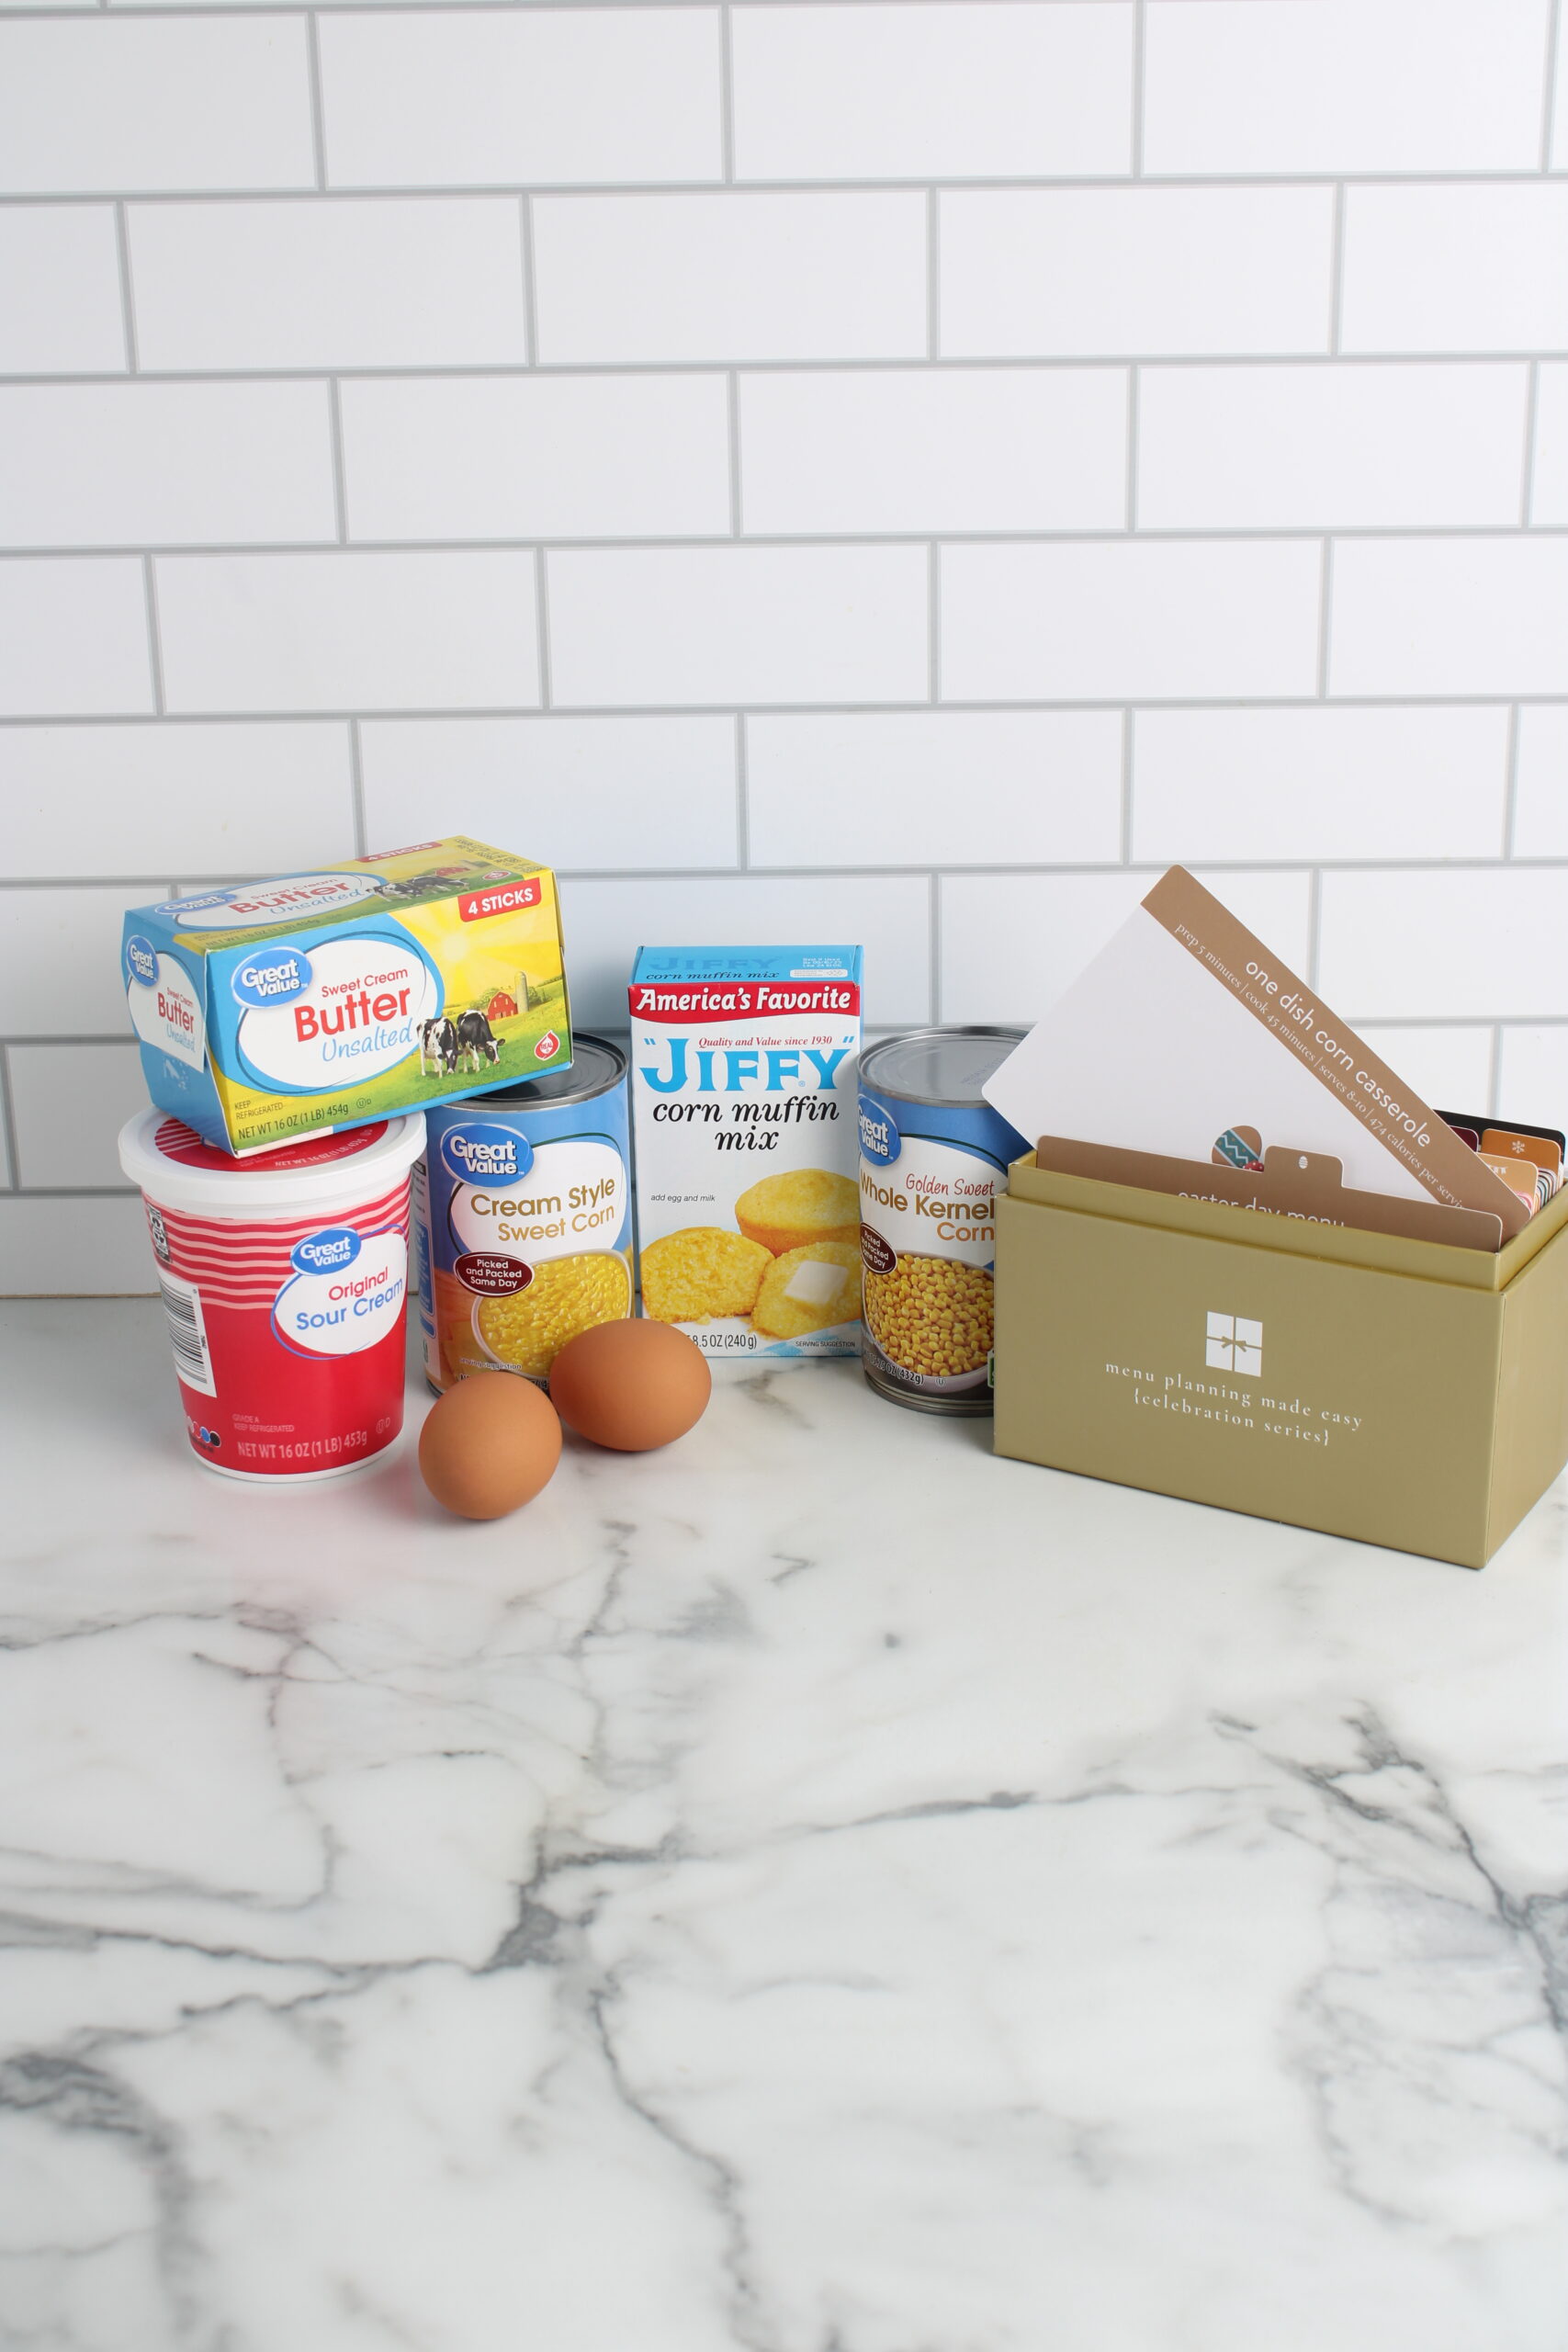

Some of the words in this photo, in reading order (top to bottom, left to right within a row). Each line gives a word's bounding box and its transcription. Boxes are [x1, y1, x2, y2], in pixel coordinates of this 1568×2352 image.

[380, 843, 434, 858] STICKS
[228, 882, 350, 913] Butter
[269, 888, 361, 914] Unsalted
[468, 901, 479, 915] 4
[481, 888, 534, 912] STICKS
[130, 944, 154, 969] Great
[136, 961, 154, 979] Value
[242, 959, 299, 988] Great
[687, 971, 743, 979] muffin
[256, 978, 300, 998] Value
[321, 980, 361, 998] Sweet
[364, 968, 409, 987] Cream
[636, 987, 750, 1011] America's
[756, 986, 851, 1010] Favorite
[157, 992, 195, 1034] Butter
[294, 988, 411, 1043] Butter
[166, 1023, 196, 1054] Unsalted
[322, 1017, 413, 1062] Unsalted
[699, 1037, 732, 1048] Quality
[735, 1036, 753, 1046] and
[756, 1036, 781, 1046] Value
[784, 1036, 808, 1046] since
[811, 1035, 832, 1045] 1930
[1175, 923, 1199, 947] prep
[1197, 944, 1206, 955] 5
[1205, 952, 1242, 989] minutes
[1246, 991, 1269, 1014] cook
[1267, 1014, 1280, 1027] 45
[1280, 1024, 1316, 1061] minutes
[1319, 1065, 1347, 1092] serves
[1346, 1091, 1367, 1112] 8-10
[1370, 1117, 1388, 1136] 474
[1387, 1132, 1422, 1169] calories
[1419, 1168, 1438, 1184] per
[1246, 962, 1279, 995] one
[1280, 993, 1314, 1031] dish
[1315, 1031, 1354, 1071] corn
[1355, 1070, 1430, 1148] casserole
[234, 1100, 251, 1110] KEEP
[236, 1102, 284, 1120] REFRIGERATED
[653, 1102, 723, 1123] corn
[731, 1095, 840, 1123] muffin
[238, 1128, 255, 1139] NET
[256, 1123, 271, 1136] WT
[275, 1119, 286, 1131] 16
[287, 1114, 299, 1127] OZ
[300, 1113, 308, 1125] (1
[310, 1109, 325, 1121] LB)
[327, 1103, 349, 1117] 454g
[450, 1136, 516, 1161] Great
[715, 1125, 779, 1150] mix
[862, 1129, 888, 1157] Value
[465, 1158, 517, 1174] Value
[860, 1169, 908, 1212] Whole
[916, 1194, 994, 1220] Kernel
[906, 1172, 949, 1195] Golden
[954, 1178, 994, 1196] Sweet
[470, 1193, 561, 1217] Cream
[569, 1178, 615, 1209] Style
[667, 1195, 682, 1204] egg
[498, 1218, 566, 1242] Sweet
[571, 1205, 615, 1232] Corn
[937, 1221, 994, 1241] Corn
[299, 1237, 351, 1260] Great
[313, 1251, 351, 1267] Value
[466, 1268, 483, 1276] and
[485, 1269, 522, 1279] Packed
[477, 1259, 509, 1269] Picked
[874, 1255, 886, 1268] Day
[329, 1266, 388, 1300] Original
[470, 1277, 496, 1287] Same
[498, 1279, 517, 1289] Day
[296, 1307, 347, 1330] Sour
[353, 1278, 402, 1317] Cream
[710, 1335, 723, 1347] OZ
[725, 1334, 747, 1349] (240
[748, 1335, 757, 1350] g)
[886, 1364, 897, 1375] OZ
[897, 1366, 924, 1385] (432g)
[1105, 1363, 1155, 1382] menu
[1165, 1374, 1252, 1407] planning
[1261, 1396, 1312, 1417] made
[1320, 1408, 1362, 1430] easy
[249, 1423, 295, 1432] REFRIGERATED
[1134, 1387, 1254, 1429] {celebration
[1264, 1421, 1329, 1446] series}
[238, 1442, 257, 1457] NET
[258, 1442, 276, 1458] WT
[278, 1444, 293, 1459] 16
[295, 1443, 310, 1457] OZ
[311, 1442, 321, 1457] (1
[324, 1437, 343, 1453] LB)
[344, 1430, 367, 1447] 453g
